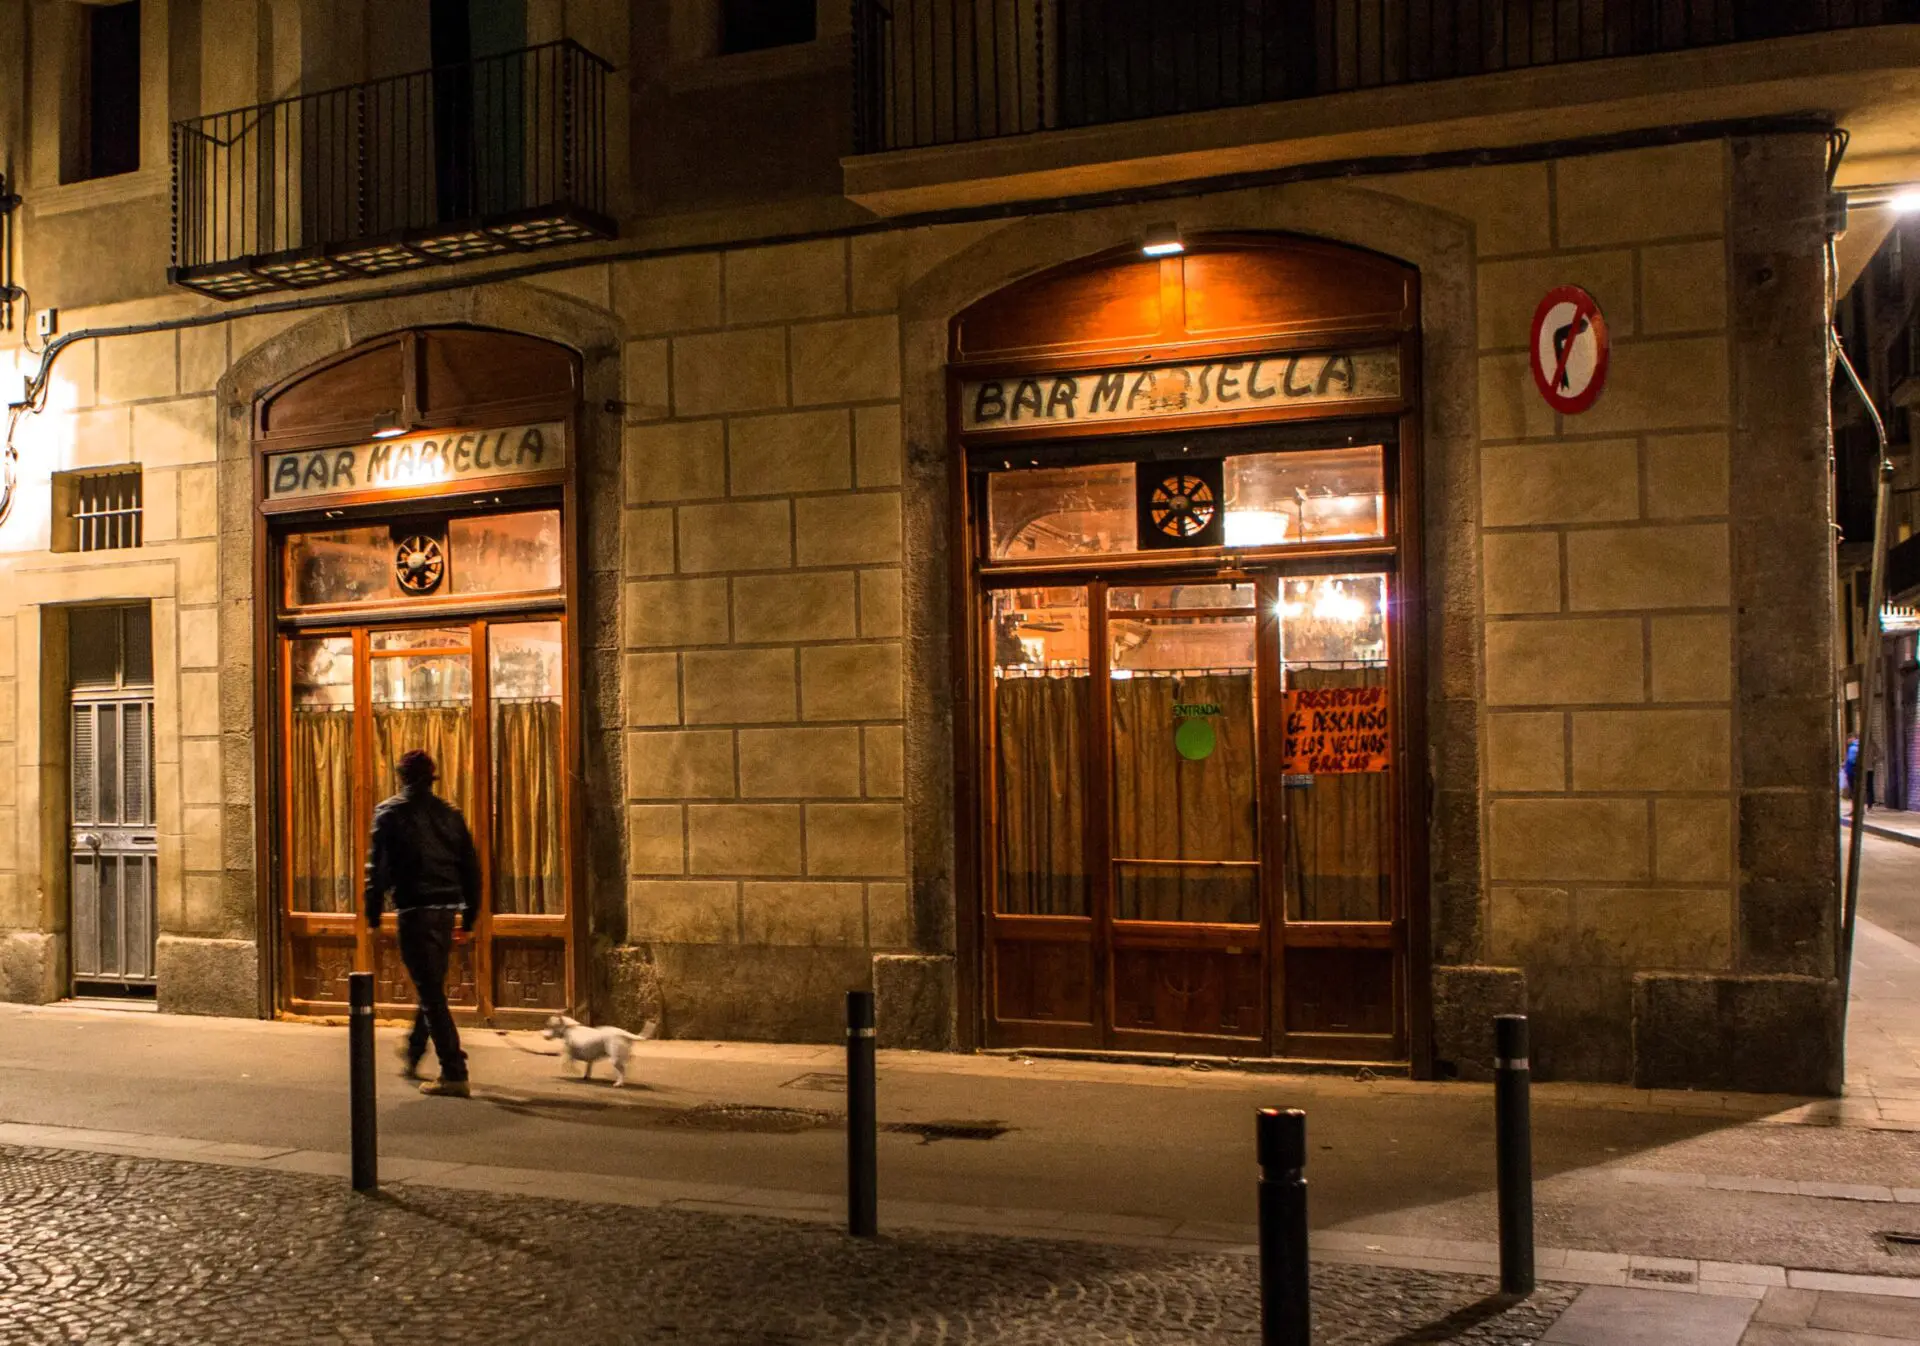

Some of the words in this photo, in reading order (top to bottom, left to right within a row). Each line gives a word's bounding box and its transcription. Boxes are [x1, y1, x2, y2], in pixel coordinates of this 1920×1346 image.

[975, 376, 1080, 422] BAR
[273, 450, 356, 493] BAR
[366, 428, 545, 484] MARSELLA
[1173, 704, 1222, 716] ENTRADA
[1295, 687, 1381, 711] RESPETEN
[1286, 711, 1306, 735] EL
[1311, 706, 1387, 733] DESCANSO
[1284, 737, 1299, 757] DE
[1301, 735, 1325, 755] LOS
[1331, 732, 1388, 755] VECINOS
[1308, 754, 1370, 772] GRACIAS
